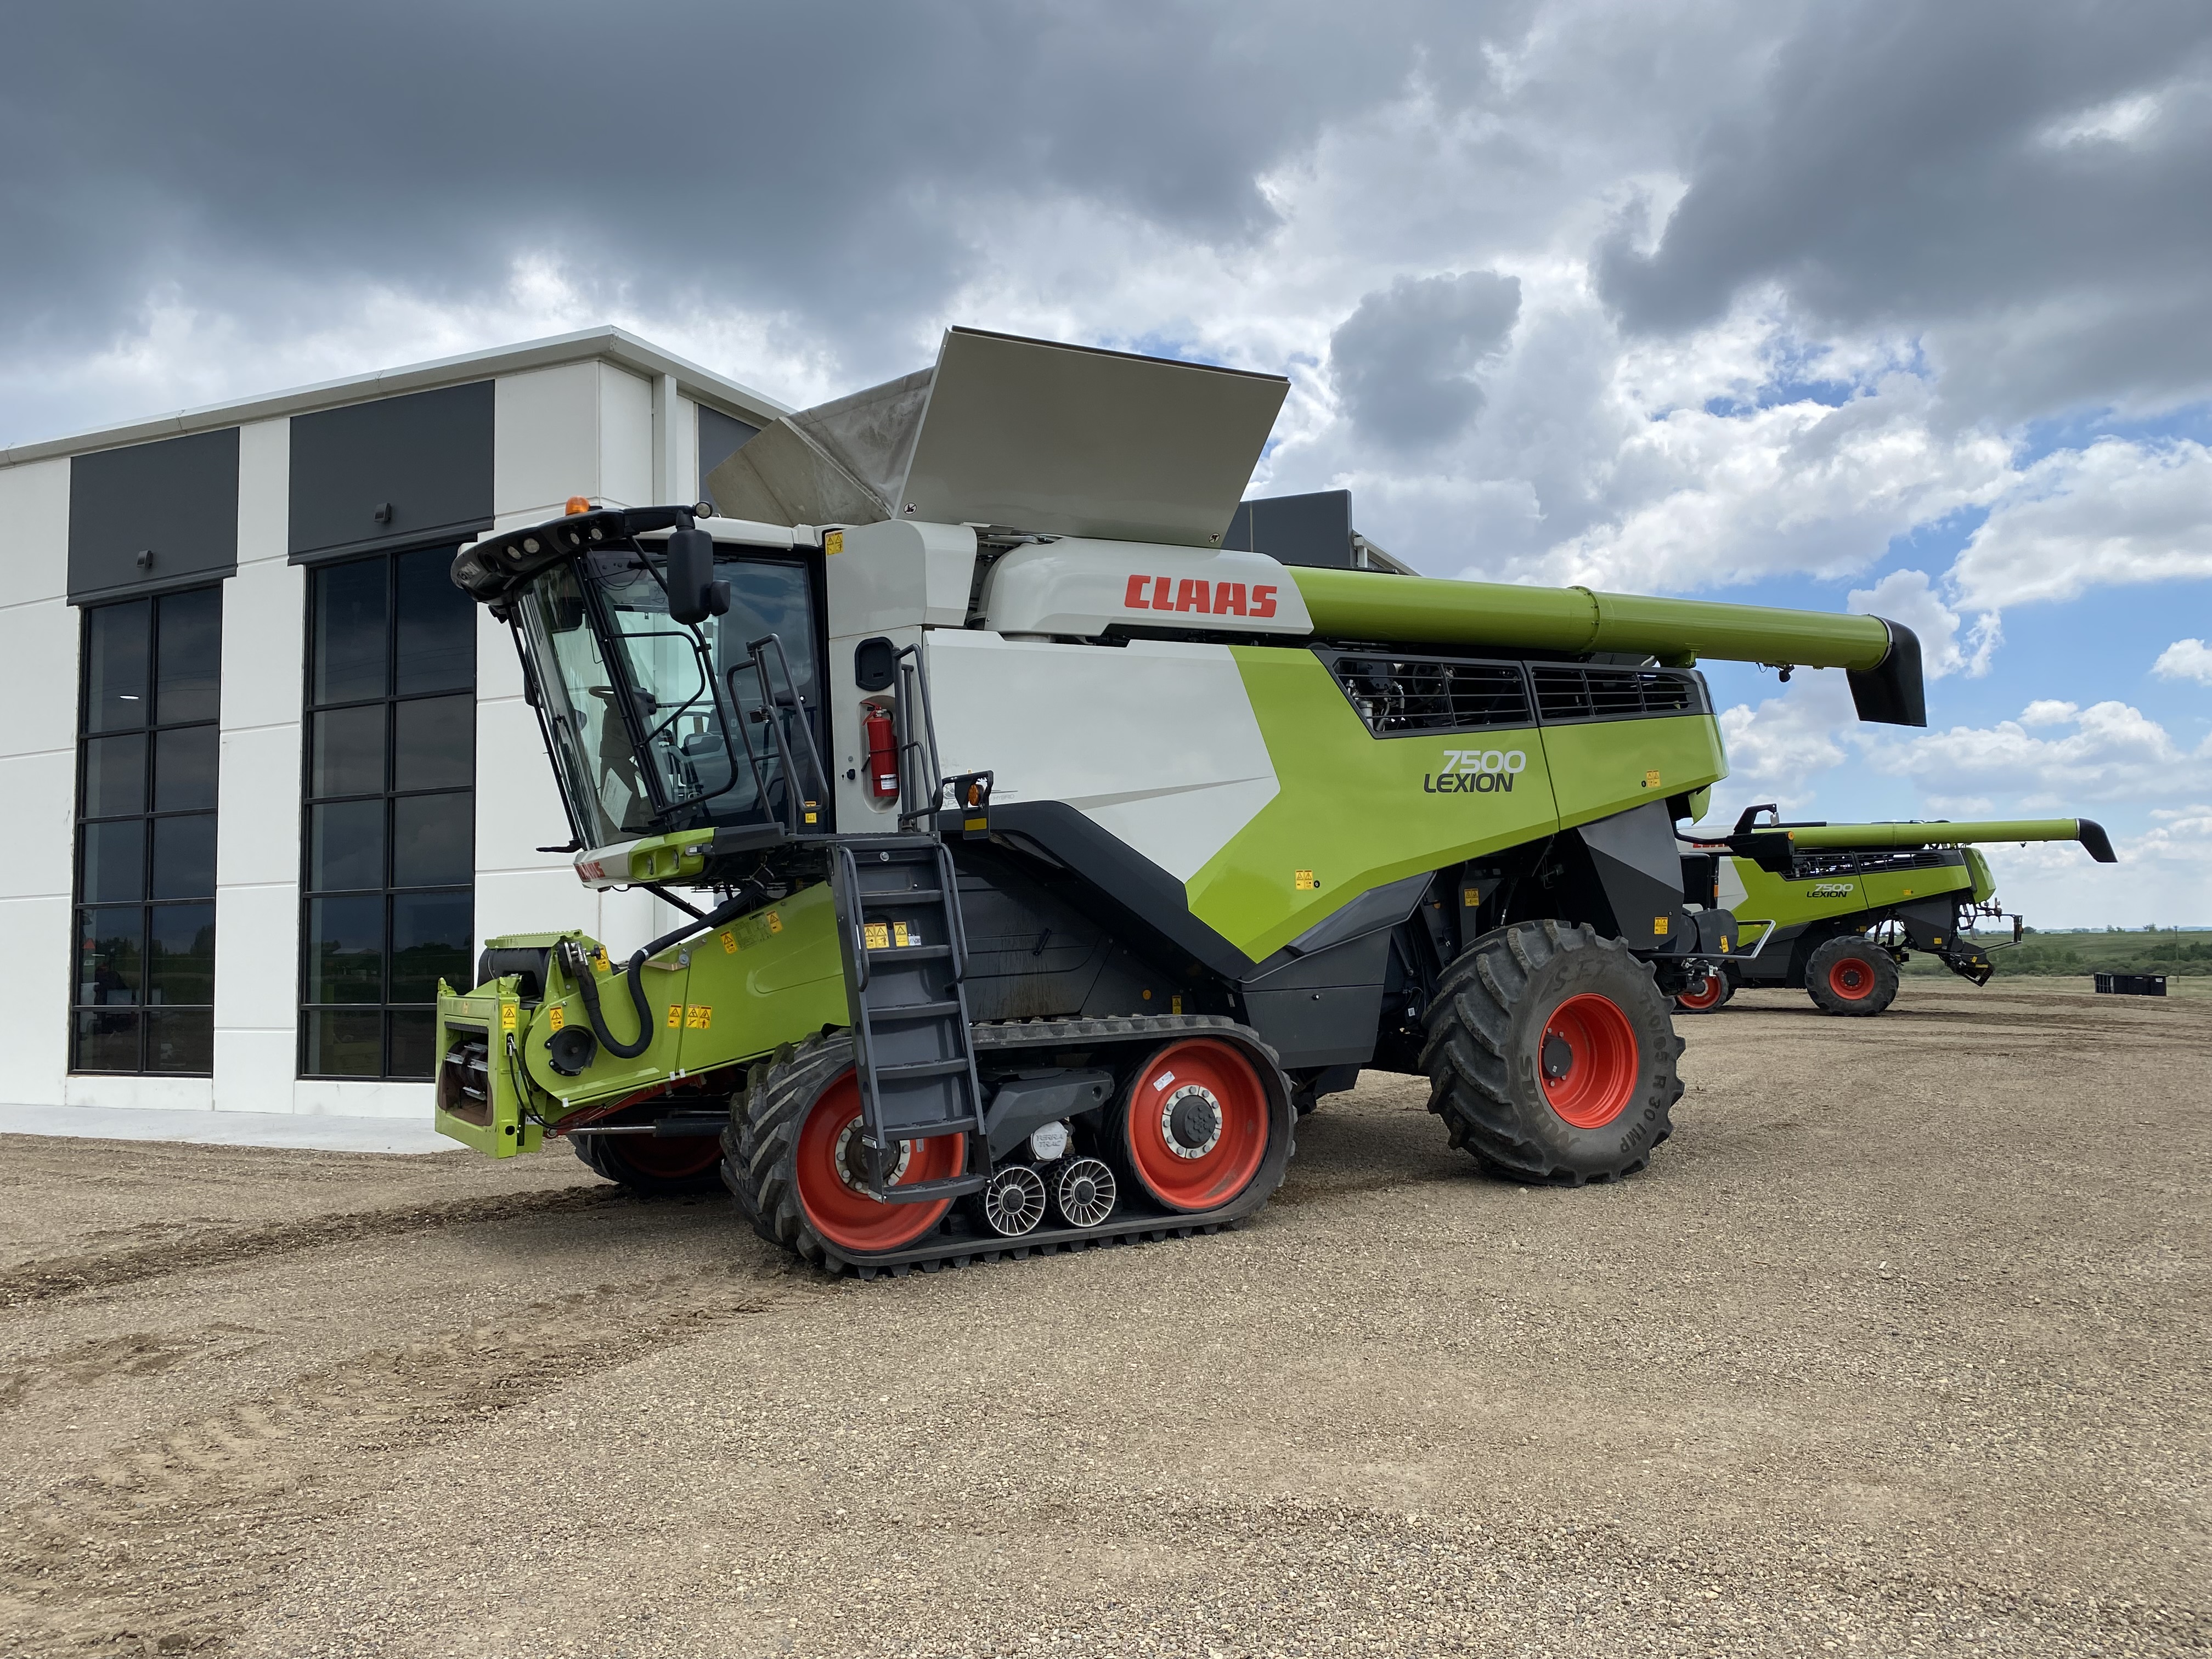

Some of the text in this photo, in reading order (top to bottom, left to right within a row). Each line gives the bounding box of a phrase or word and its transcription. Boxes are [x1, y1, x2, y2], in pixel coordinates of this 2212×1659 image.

[1124, 574, 1278, 618] CLAAS
[1442, 750, 1527, 774] 7500
[1424, 773, 1514, 793] LEXION
[1815, 883, 1854, 892] 7500
[1652, 1075, 1667, 1089] R
[1644, 1096, 1661, 1122] 30
[1620, 1122, 1647, 1153] IMP
